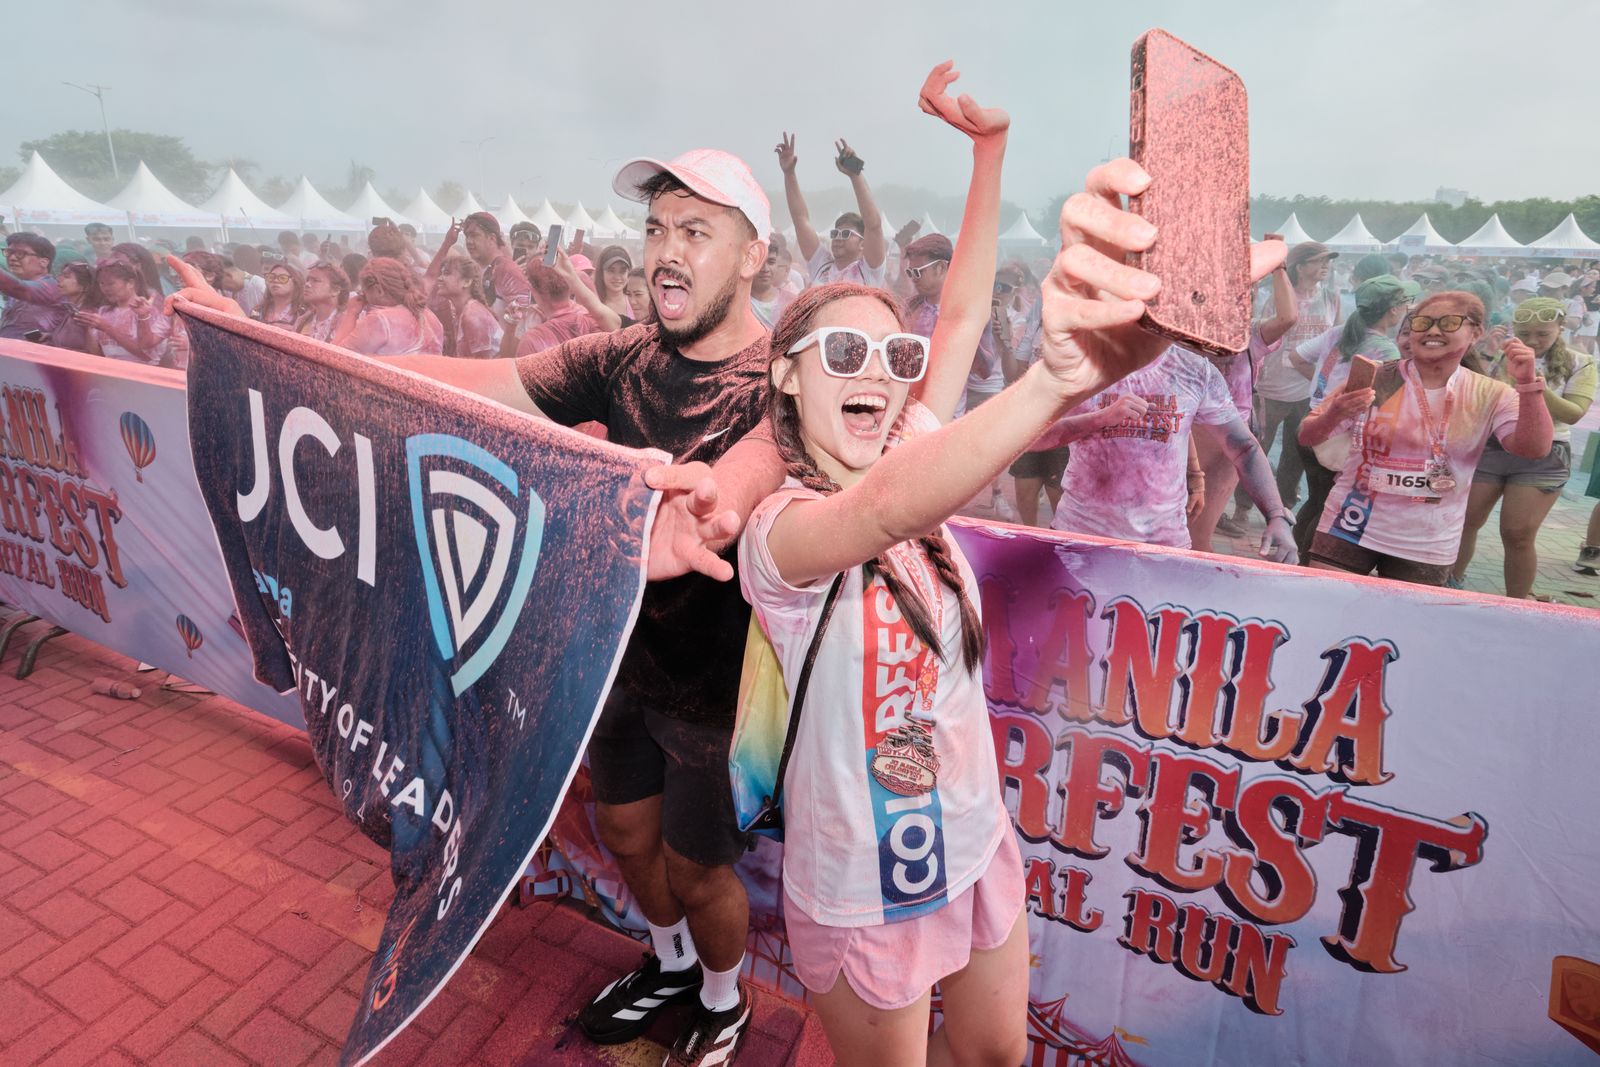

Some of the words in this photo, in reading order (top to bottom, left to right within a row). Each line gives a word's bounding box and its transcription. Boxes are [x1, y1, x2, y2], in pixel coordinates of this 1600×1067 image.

[236, 387, 377, 588] JCI
[337, 703, 374, 753] OF
[372, 741, 463, 921] LEADERS
[1116, 886, 1299, 1017] RUN
